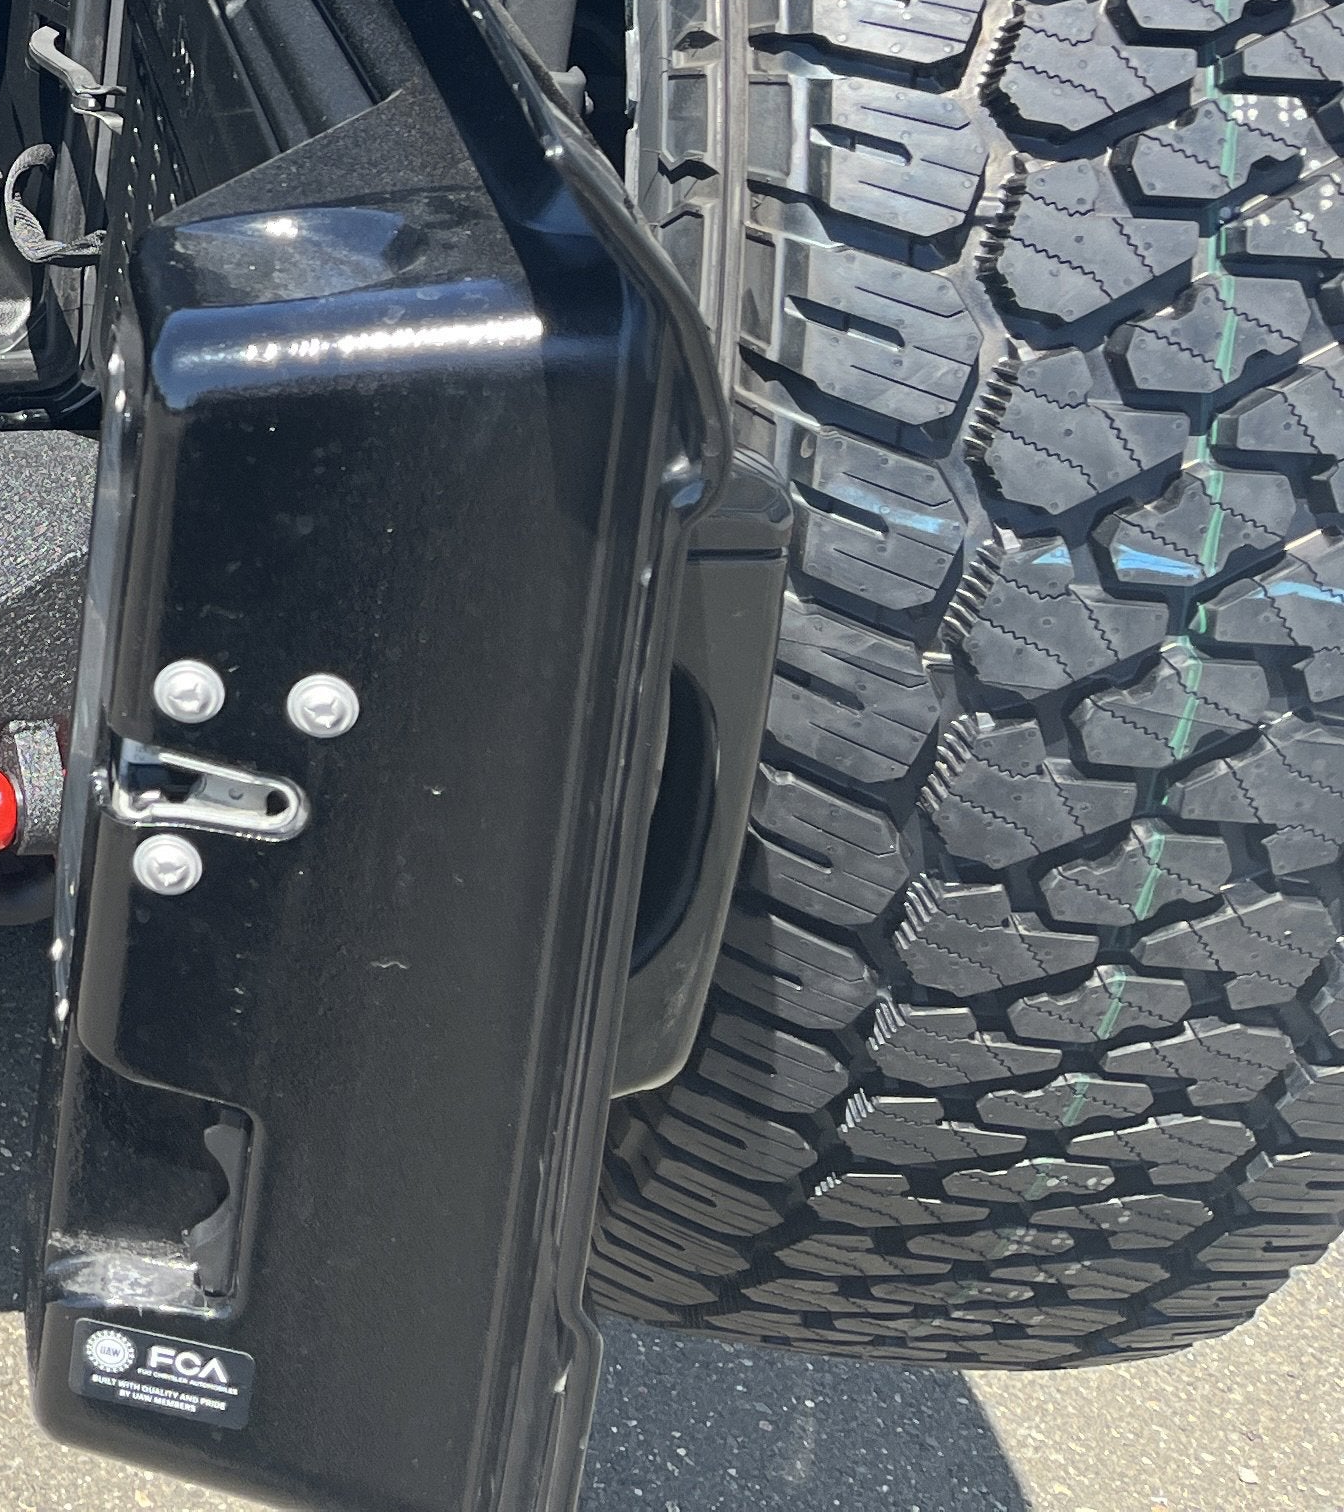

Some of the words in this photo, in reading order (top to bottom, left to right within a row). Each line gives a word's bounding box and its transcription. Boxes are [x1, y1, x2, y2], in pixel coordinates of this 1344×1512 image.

[148, 1345, 228, 1384] FCA
[91, 1373, 117, 1387] BUILT
[118, 1378, 141, 1392] WITH
[141, 1384, 179, 1400] QUALITY
[179, 1391, 199, 1404] AND
[199, 1397, 227, 1411] PRIDE
[119, 1388, 132, 1398] BY
[132, 1391, 153, 1404] UAW
[153, 1396, 197, 1413] MEMBERS
